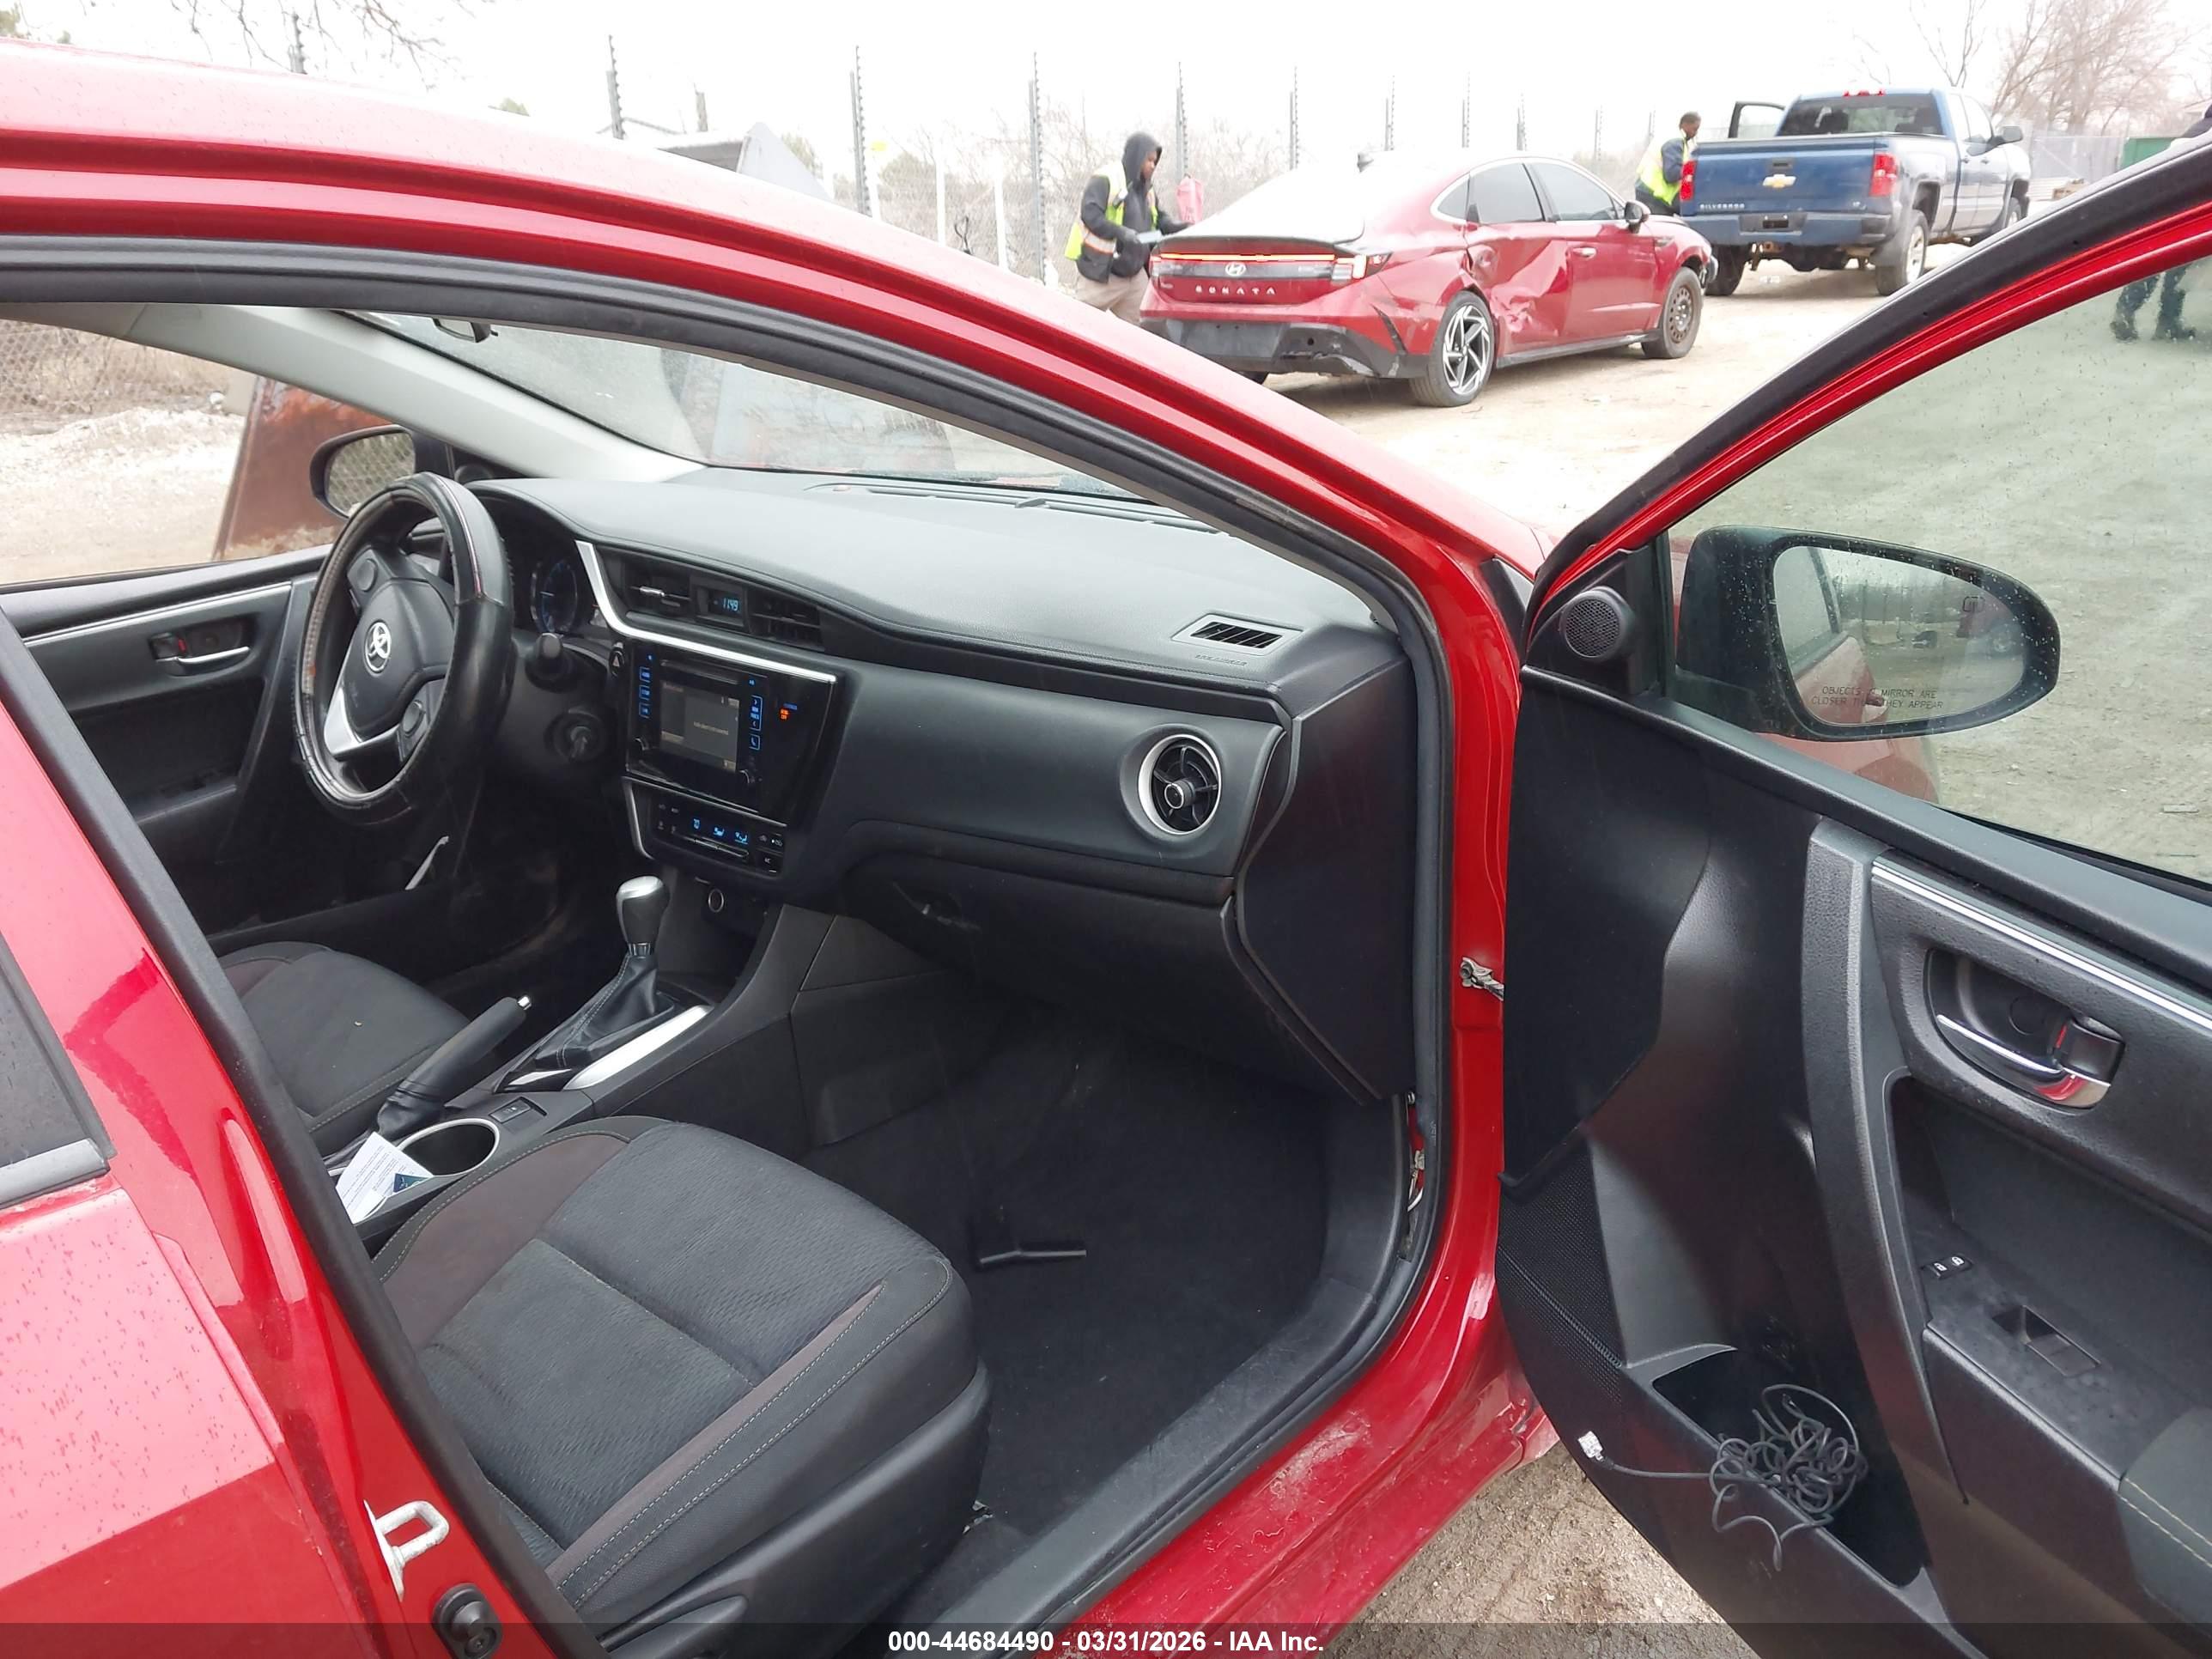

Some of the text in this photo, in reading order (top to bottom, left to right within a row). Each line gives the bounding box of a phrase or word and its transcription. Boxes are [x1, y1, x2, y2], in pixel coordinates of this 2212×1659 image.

[1195, 284, 1276, 295] SONATA
[1821, 686, 1861, 696] OBJECTS
[1881, 689, 1915, 698] MIRROR
[1919, 690, 1938, 699] ARE
[1908, 700, 1944, 709] APPEAR
